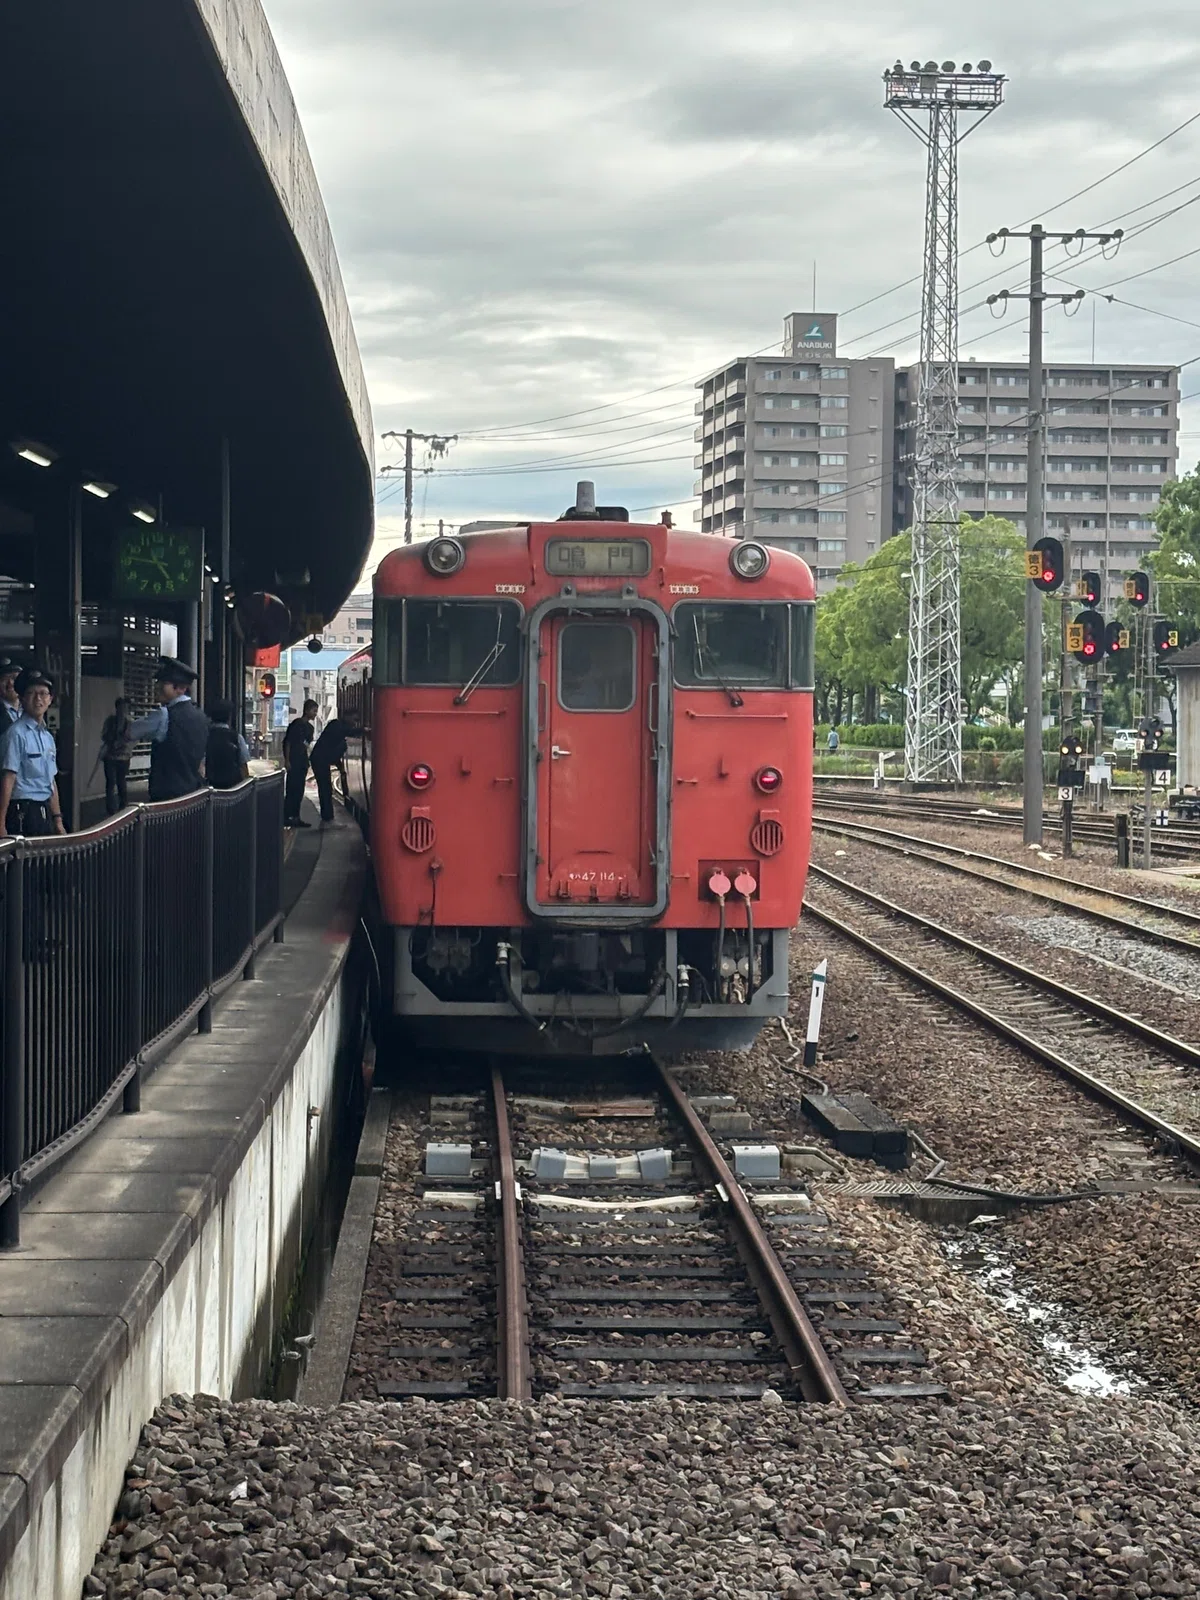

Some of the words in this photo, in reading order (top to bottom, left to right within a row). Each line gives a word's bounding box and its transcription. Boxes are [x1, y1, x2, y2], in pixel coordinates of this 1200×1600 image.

[797, 341, 833, 349] ANABUKI
[1158, 771, 1167, 784] 4
[1061, 788, 1070, 800] 3
[600, 872, 615, 881] 114
[815, 986, 820, 998] 1
